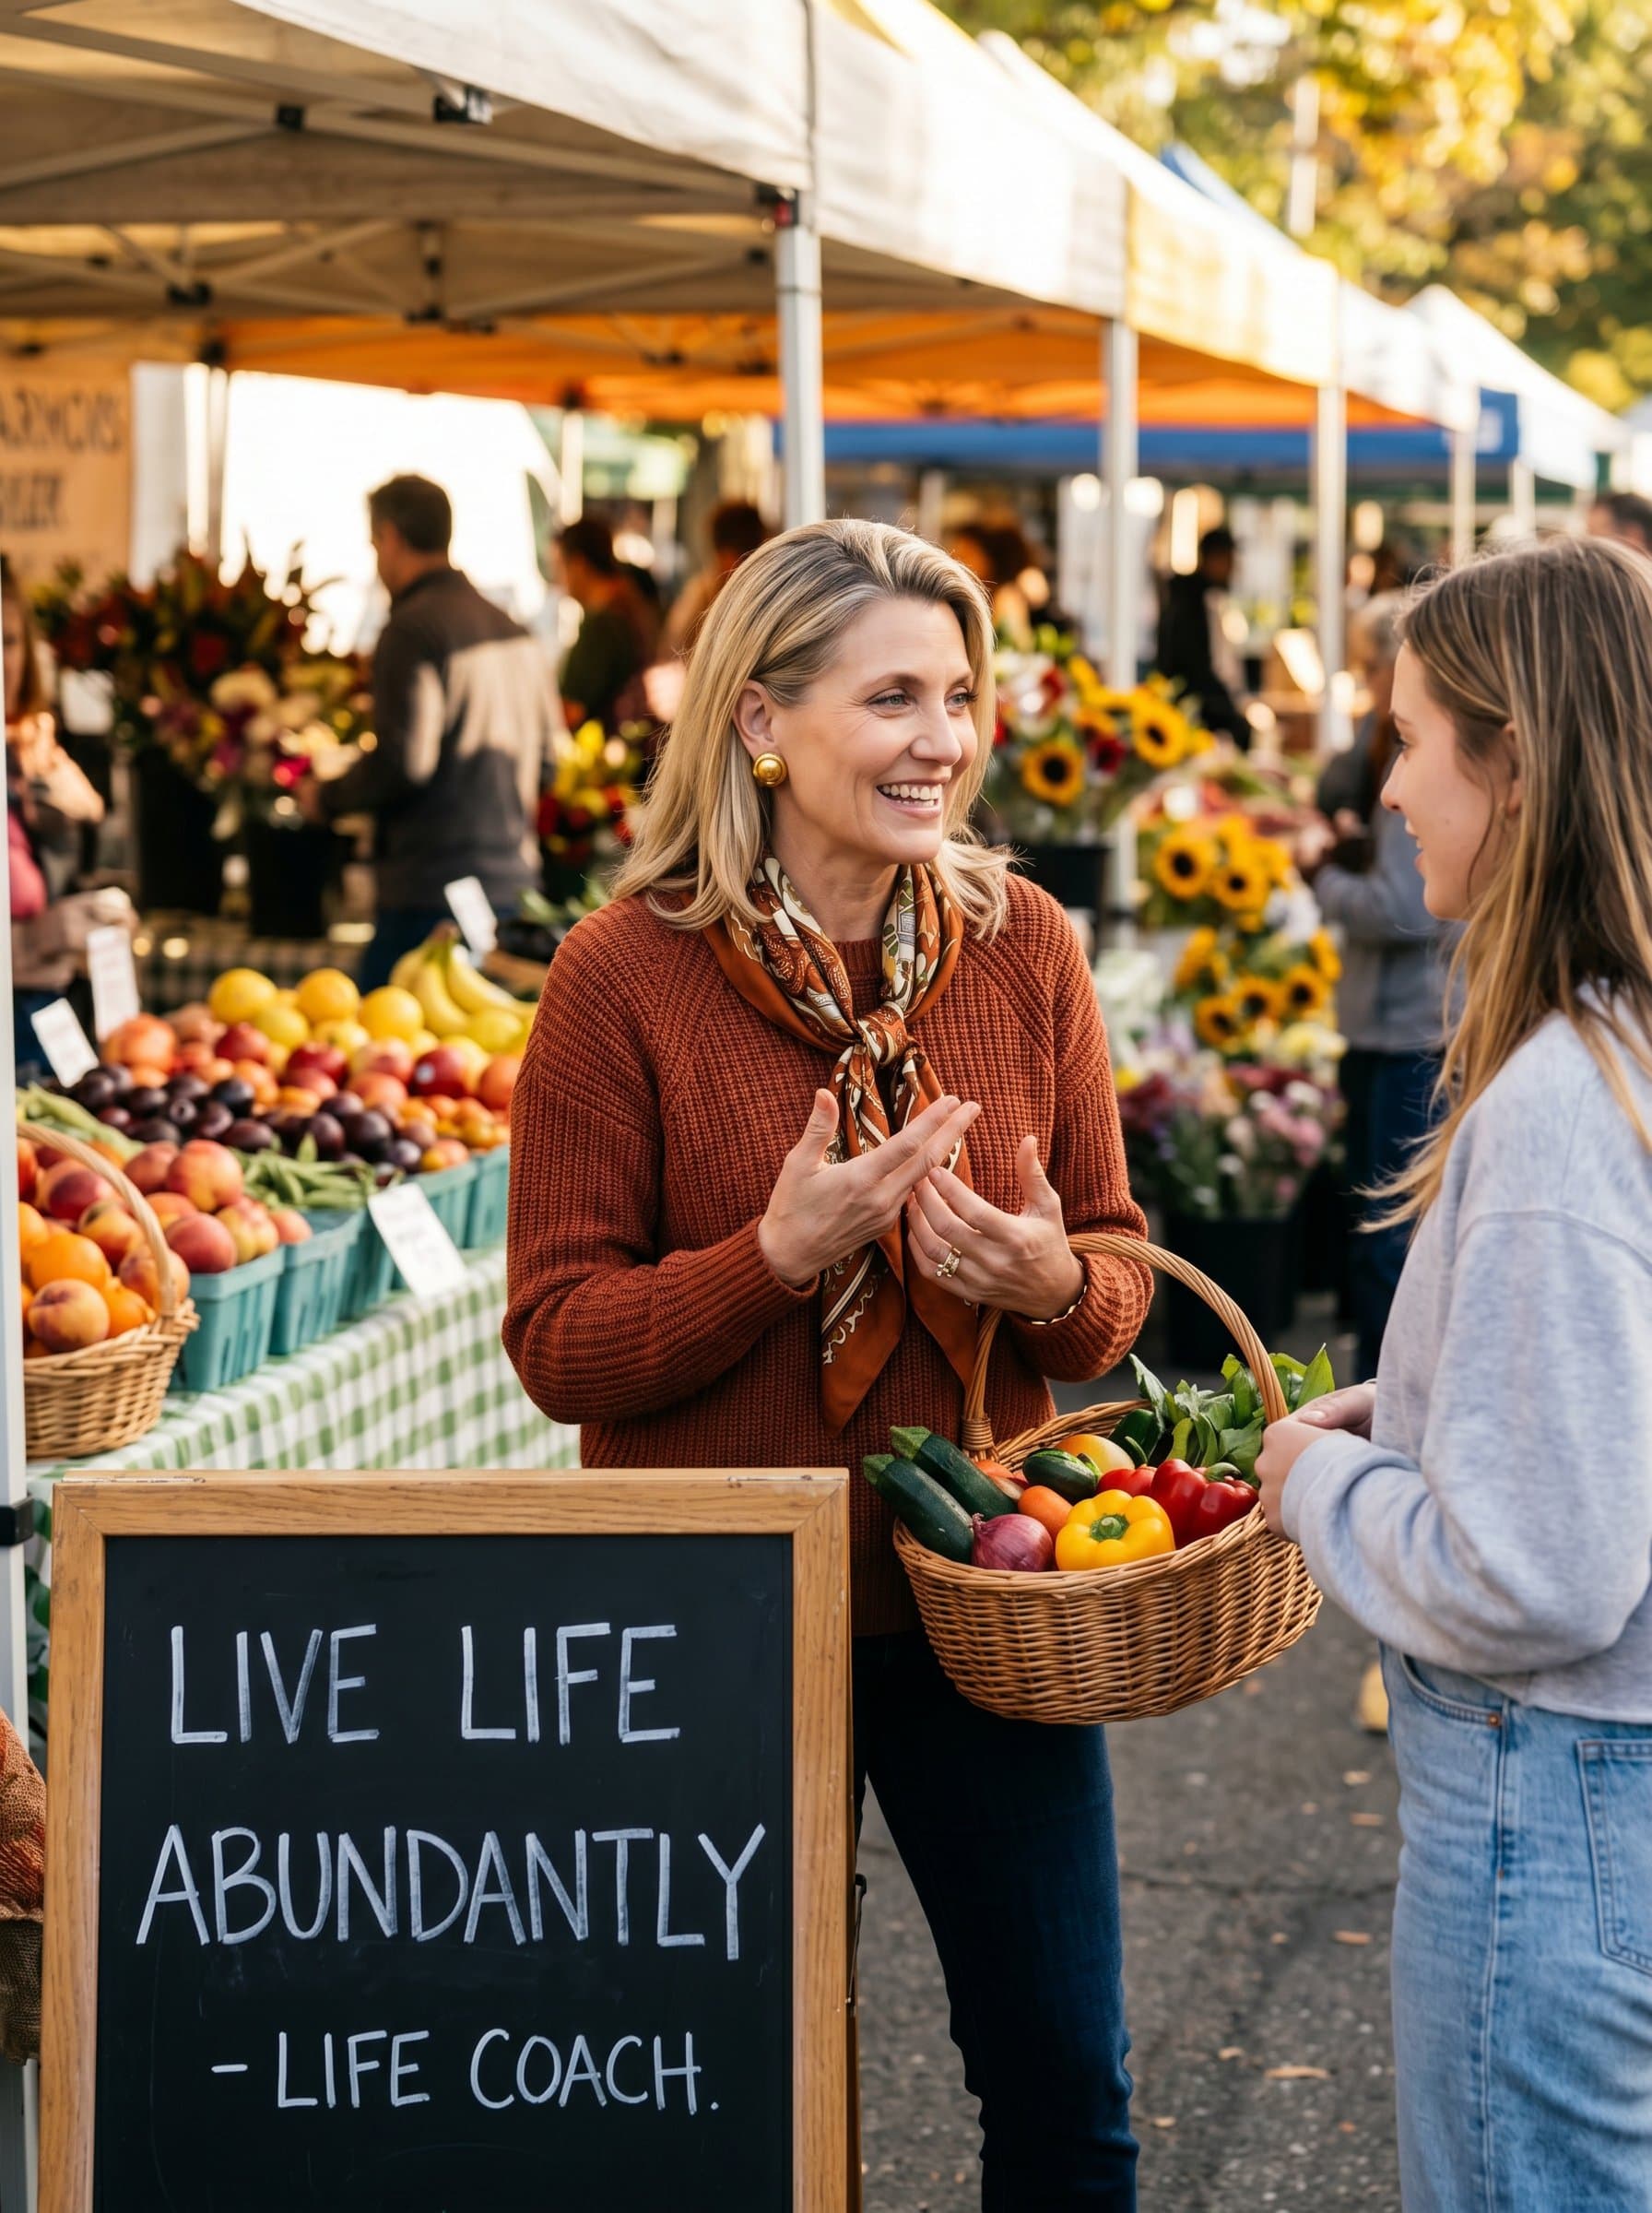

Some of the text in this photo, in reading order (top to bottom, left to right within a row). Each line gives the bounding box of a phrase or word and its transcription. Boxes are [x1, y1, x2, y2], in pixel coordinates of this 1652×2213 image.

[171, 1623, 679, 1745] LIVE LIFE
[136, 1824, 765, 1959] ABUNDANTLY
[278, 2030, 430, 2108] LIFE
[471, 2029, 718, 2114] COACH.
